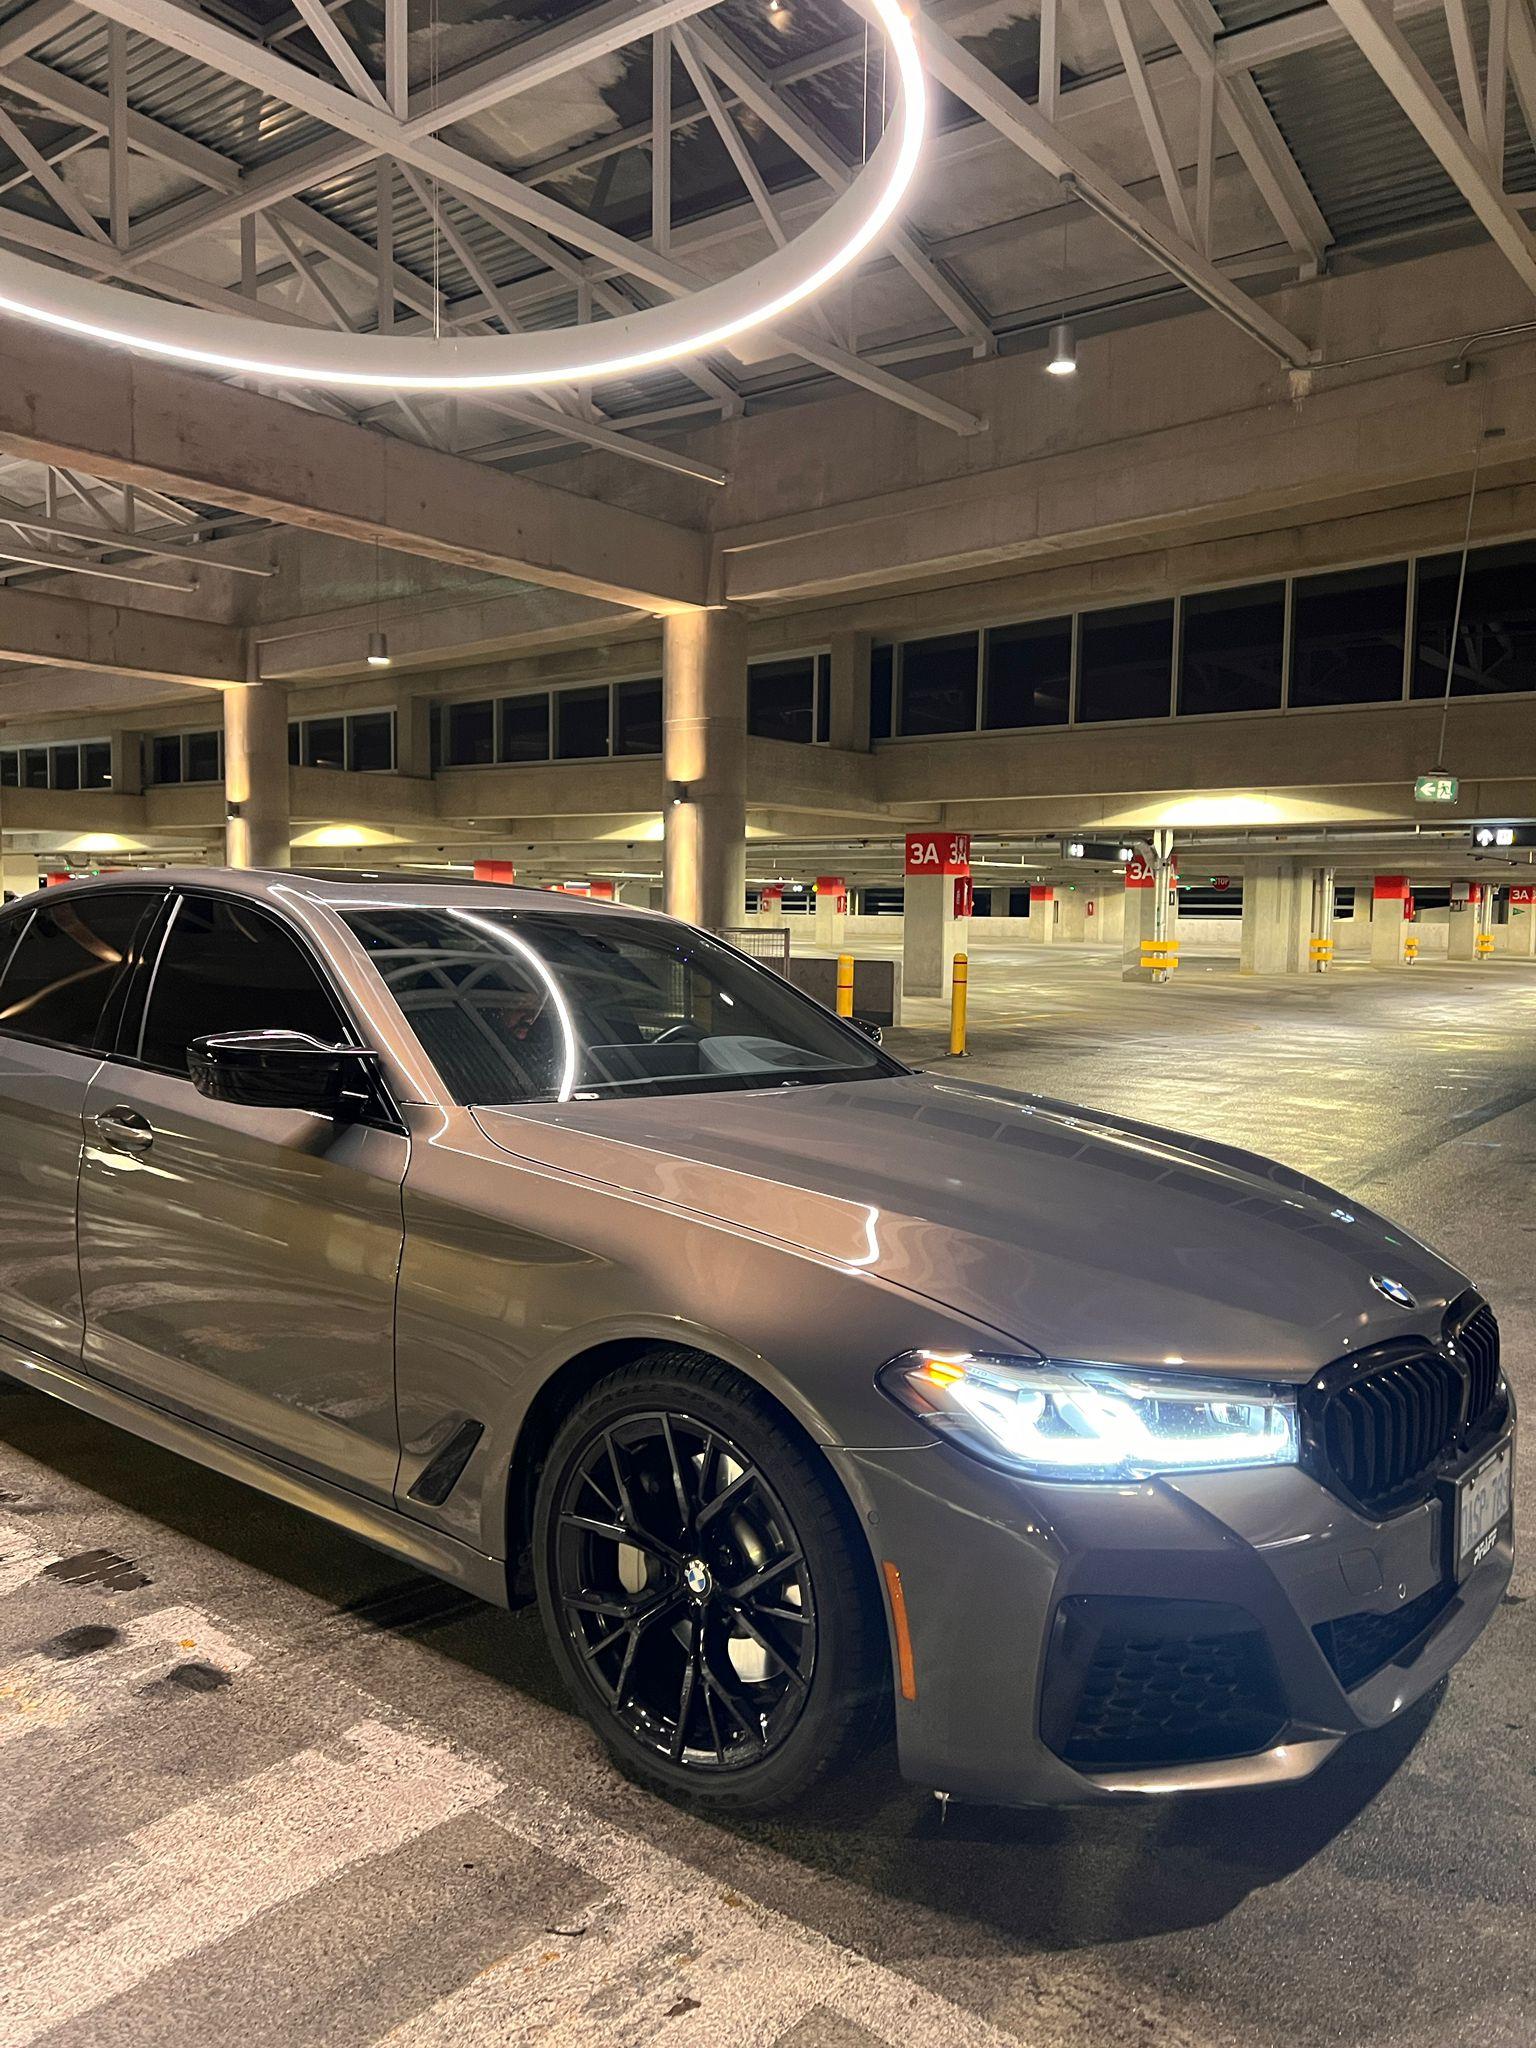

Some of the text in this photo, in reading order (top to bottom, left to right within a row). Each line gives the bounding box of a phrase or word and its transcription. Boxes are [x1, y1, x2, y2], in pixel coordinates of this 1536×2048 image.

[910, 843, 939, 864] 3A
[949, 843, 967, 864] 3A
[1130, 863, 1154, 880] 3A
[1512, 890, 1529, 900] 3A
